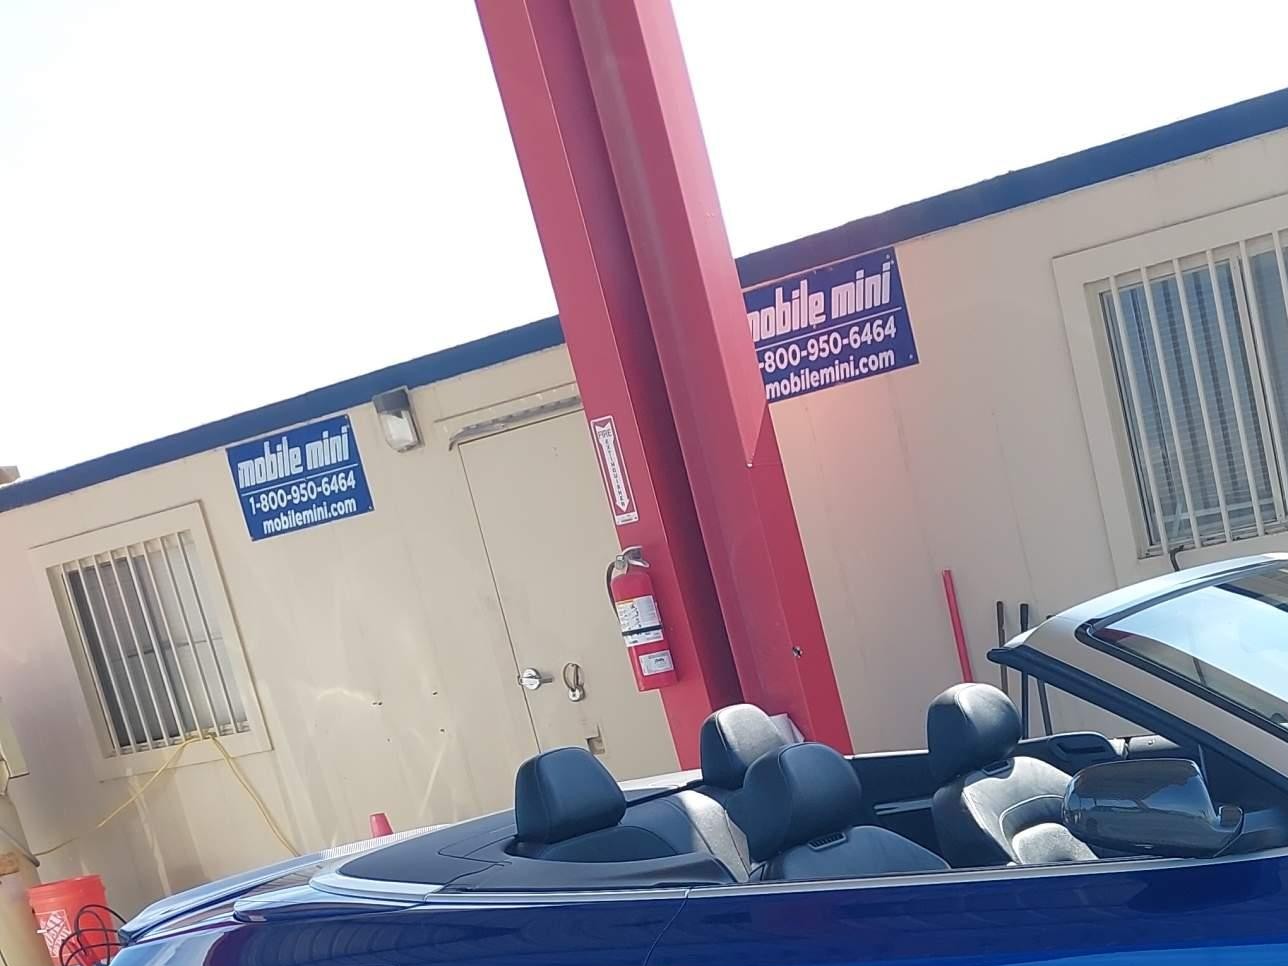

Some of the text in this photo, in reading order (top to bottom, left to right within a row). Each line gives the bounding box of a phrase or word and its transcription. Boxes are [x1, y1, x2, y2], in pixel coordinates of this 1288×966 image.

[831, 261, 891, 320] mini
[758, 315, 897, 373] -800-950-6464
[765, 349, 895, 400] mobilemini.com
[237, 425, 350, 489] mobile mini
[597, 428, 612, 438] FIRE
[249, 470, 356, 515] 1-800-950-6464
[605, 439, 625, 507] EXTINGUISHER
[263, 498, 357, 534] mobilemini.com
